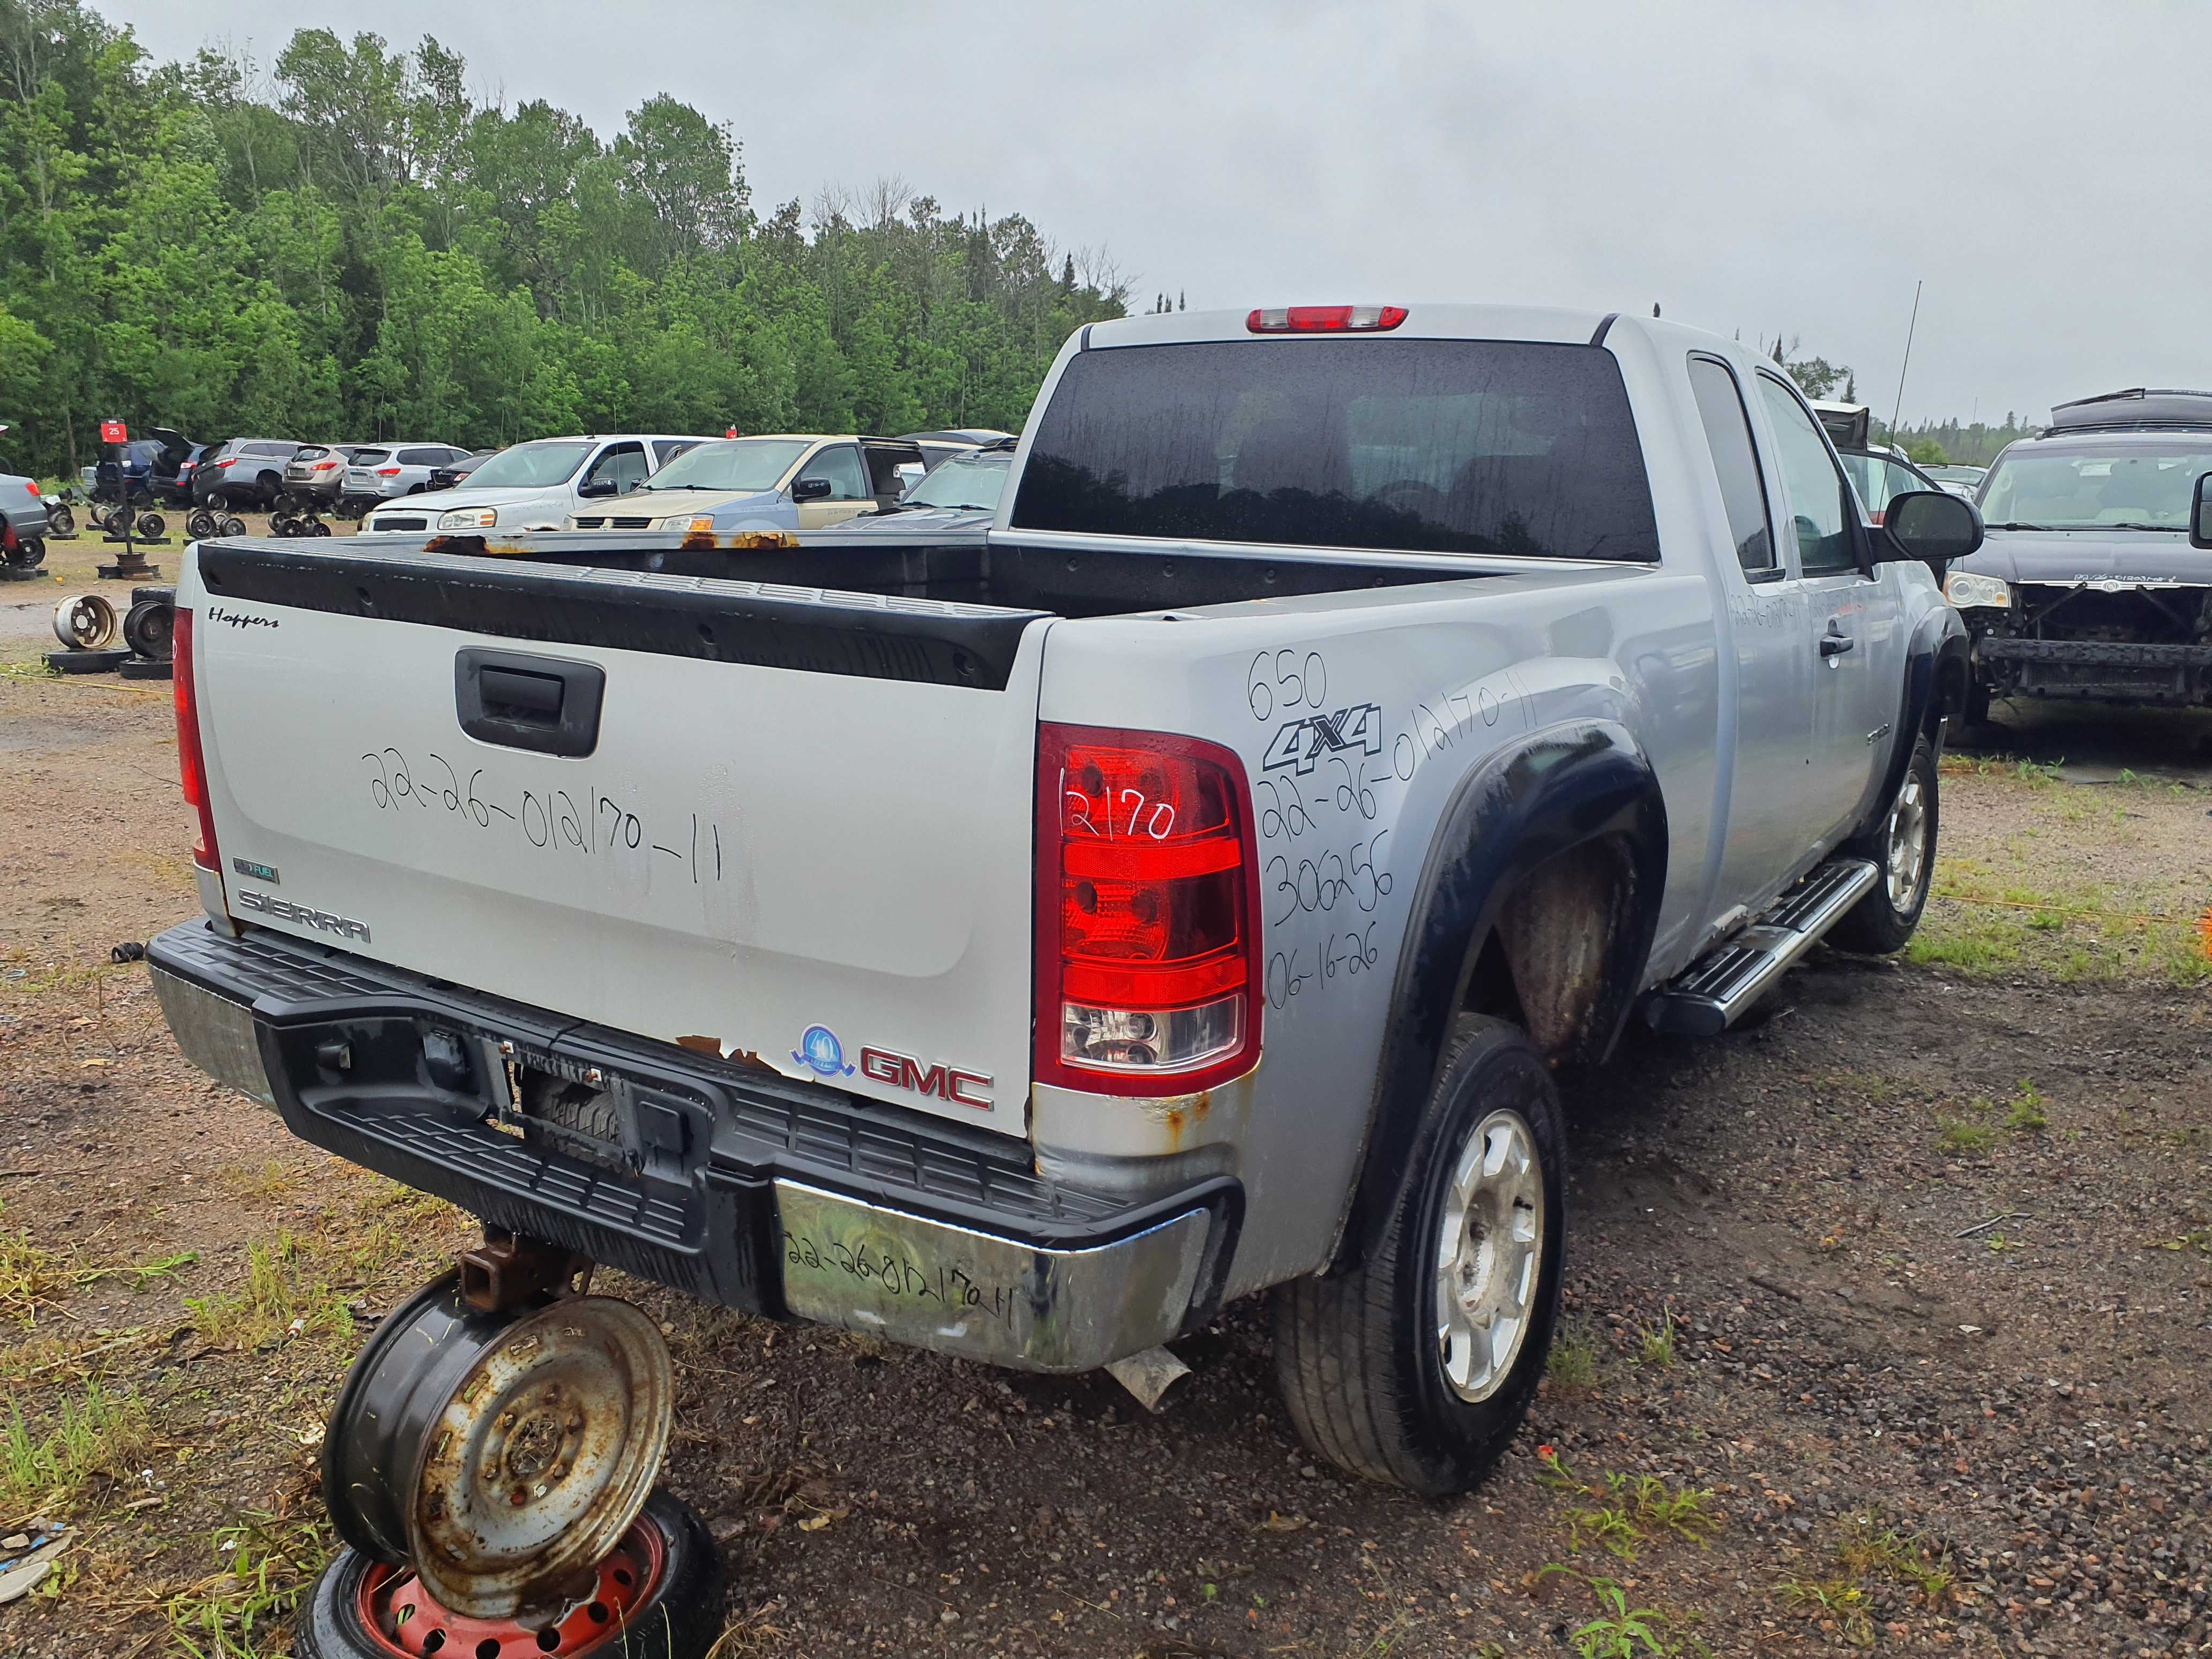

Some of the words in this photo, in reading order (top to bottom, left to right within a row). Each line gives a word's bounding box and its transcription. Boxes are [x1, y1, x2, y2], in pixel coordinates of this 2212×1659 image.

[1248, 649, 1326, 721] 650
[362, 748, 721, 884] 22-26-012170-11
[1058, 767, 1175, 841] 12170
[238, 887, 371, 944] SIERRA
[1267, 921, 1378, 1010] 06-16-26
[861, 1044, 994, 1112] GMC
